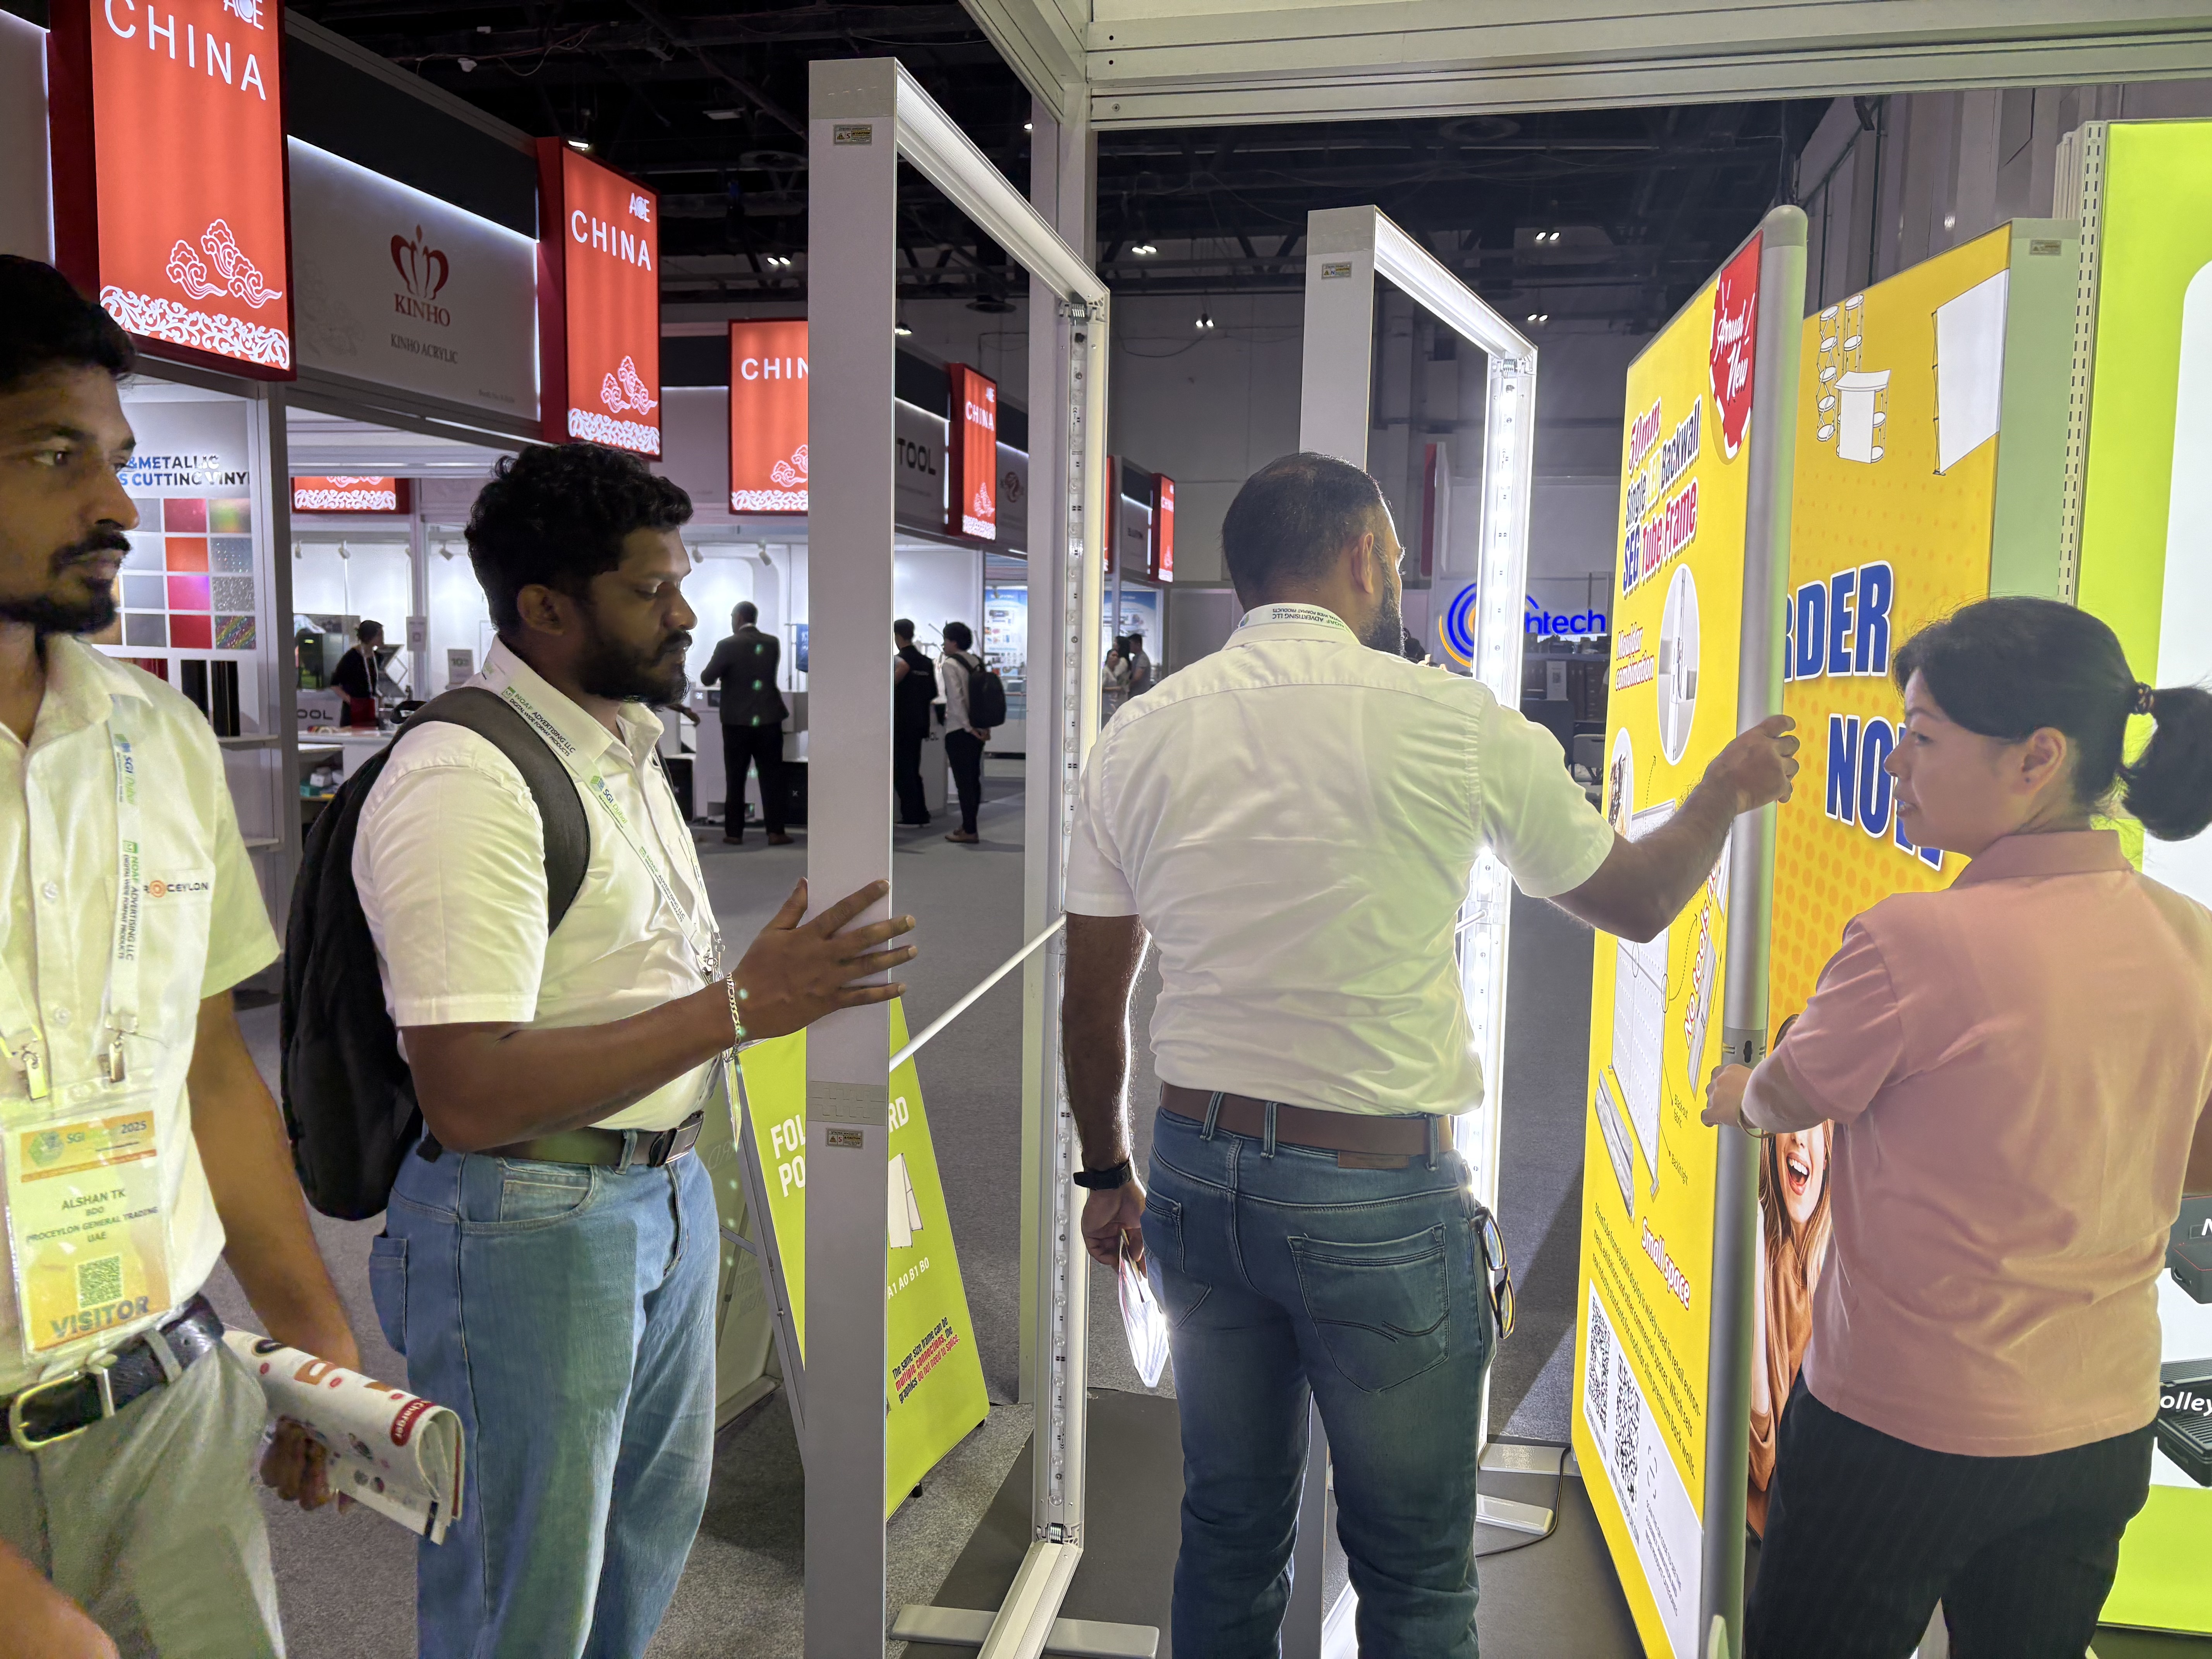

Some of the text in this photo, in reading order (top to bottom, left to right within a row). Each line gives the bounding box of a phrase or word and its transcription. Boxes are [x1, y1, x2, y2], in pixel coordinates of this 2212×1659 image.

[105, 0, 266, 100] CHINA
[572, 210, 651, 271] CHINA
[394, 293, 450, 326] KINHO
[391, 333, 459, 364] KINHO ACRYLIC
[741, 357, 808, 380] CHIN
[1727, 340, 1748, 401] New
[966, 401, 994, 431] CHINA
[1629, 397, 1661, 472] 50mm
[132, 472, 202, 486] CUTTING
[1626, 469, 1647, 531] Single
[1661, 396, 1701, 490] Backwall
[1623, 480, 1697, 592] SEG Tube Frame
[1285, 614, 1324, 622] ADVERTISING
[1785, 560, 1894, 683] DER
[1615, 649, 1654, 691] combination
[297, 709, 333, 720] OOL
[510, 698, 524, 714] DIGITAL
[534, 721, 551, 736] FORMAT
[549, 735, 570, 756] PRODUCTS
[532, 711, 566, 743] ADVERTISING
[565, 742, 576, 753] LLC
[603, 789, 614, 803] SGI
[613, 804, 628, 824] Dubai
[127, 886, 139, 944] ADVERTISING
[125, 944, 134, 961] LLC
[121, 1120, 147, 1134] 2025
[771, 1096, 909, 1159] FOL RD
[778, 1155, 805, 1197] PO
[61, 1192, 109, 1211] ALSHAN
[82, 1216, 121, 1230] GENERAL
[1641, 1216, 1690, 1311] Small space
[50, 1296, 149, 1338] VISITOR
[892, 1317, 948, 1380] The same size frame can be
[895, 1364, 916, 1392] multiple
[916, 1334, 946, 1369] connections,
[899, 1376, 918, 1404] graphics
[917, 1370, 924, 1382] do
[931, 1351, 941, 1369] need
[941, 1347, 946, 1357] to
[946, 1333, 960, 1354] splice.
[1625, 1291, 1633, 1316] other
[1633, 1312, 1655, 1355] commercial
[1654, 1352, 1669, 1385] spaces.
[1669, 1378, 1683, 1418] Which
[1683, 1411, 1692, 1437] sets
[1645, 1304, 1657, 1334] widely
[1657, 1329, 1667, 1351] used
[1667, 1342, 1671, 1358] in
[1671, 1353, 1684, 1384] retail
[1684, 1378, 1700, 1417] eviron-
[395, 1401, 431, 1438] Charger
[1630, 1329, 1644, 1368] modular
[1644, 1361, 1652, 1385] slim
[1652, 1379, 1671, 1420] premium
[1671, 1414, 1681, 1450] back
[1682, 1443, 1695, 1480] walls.
[2160, 1391, 2212, 1417] olley
